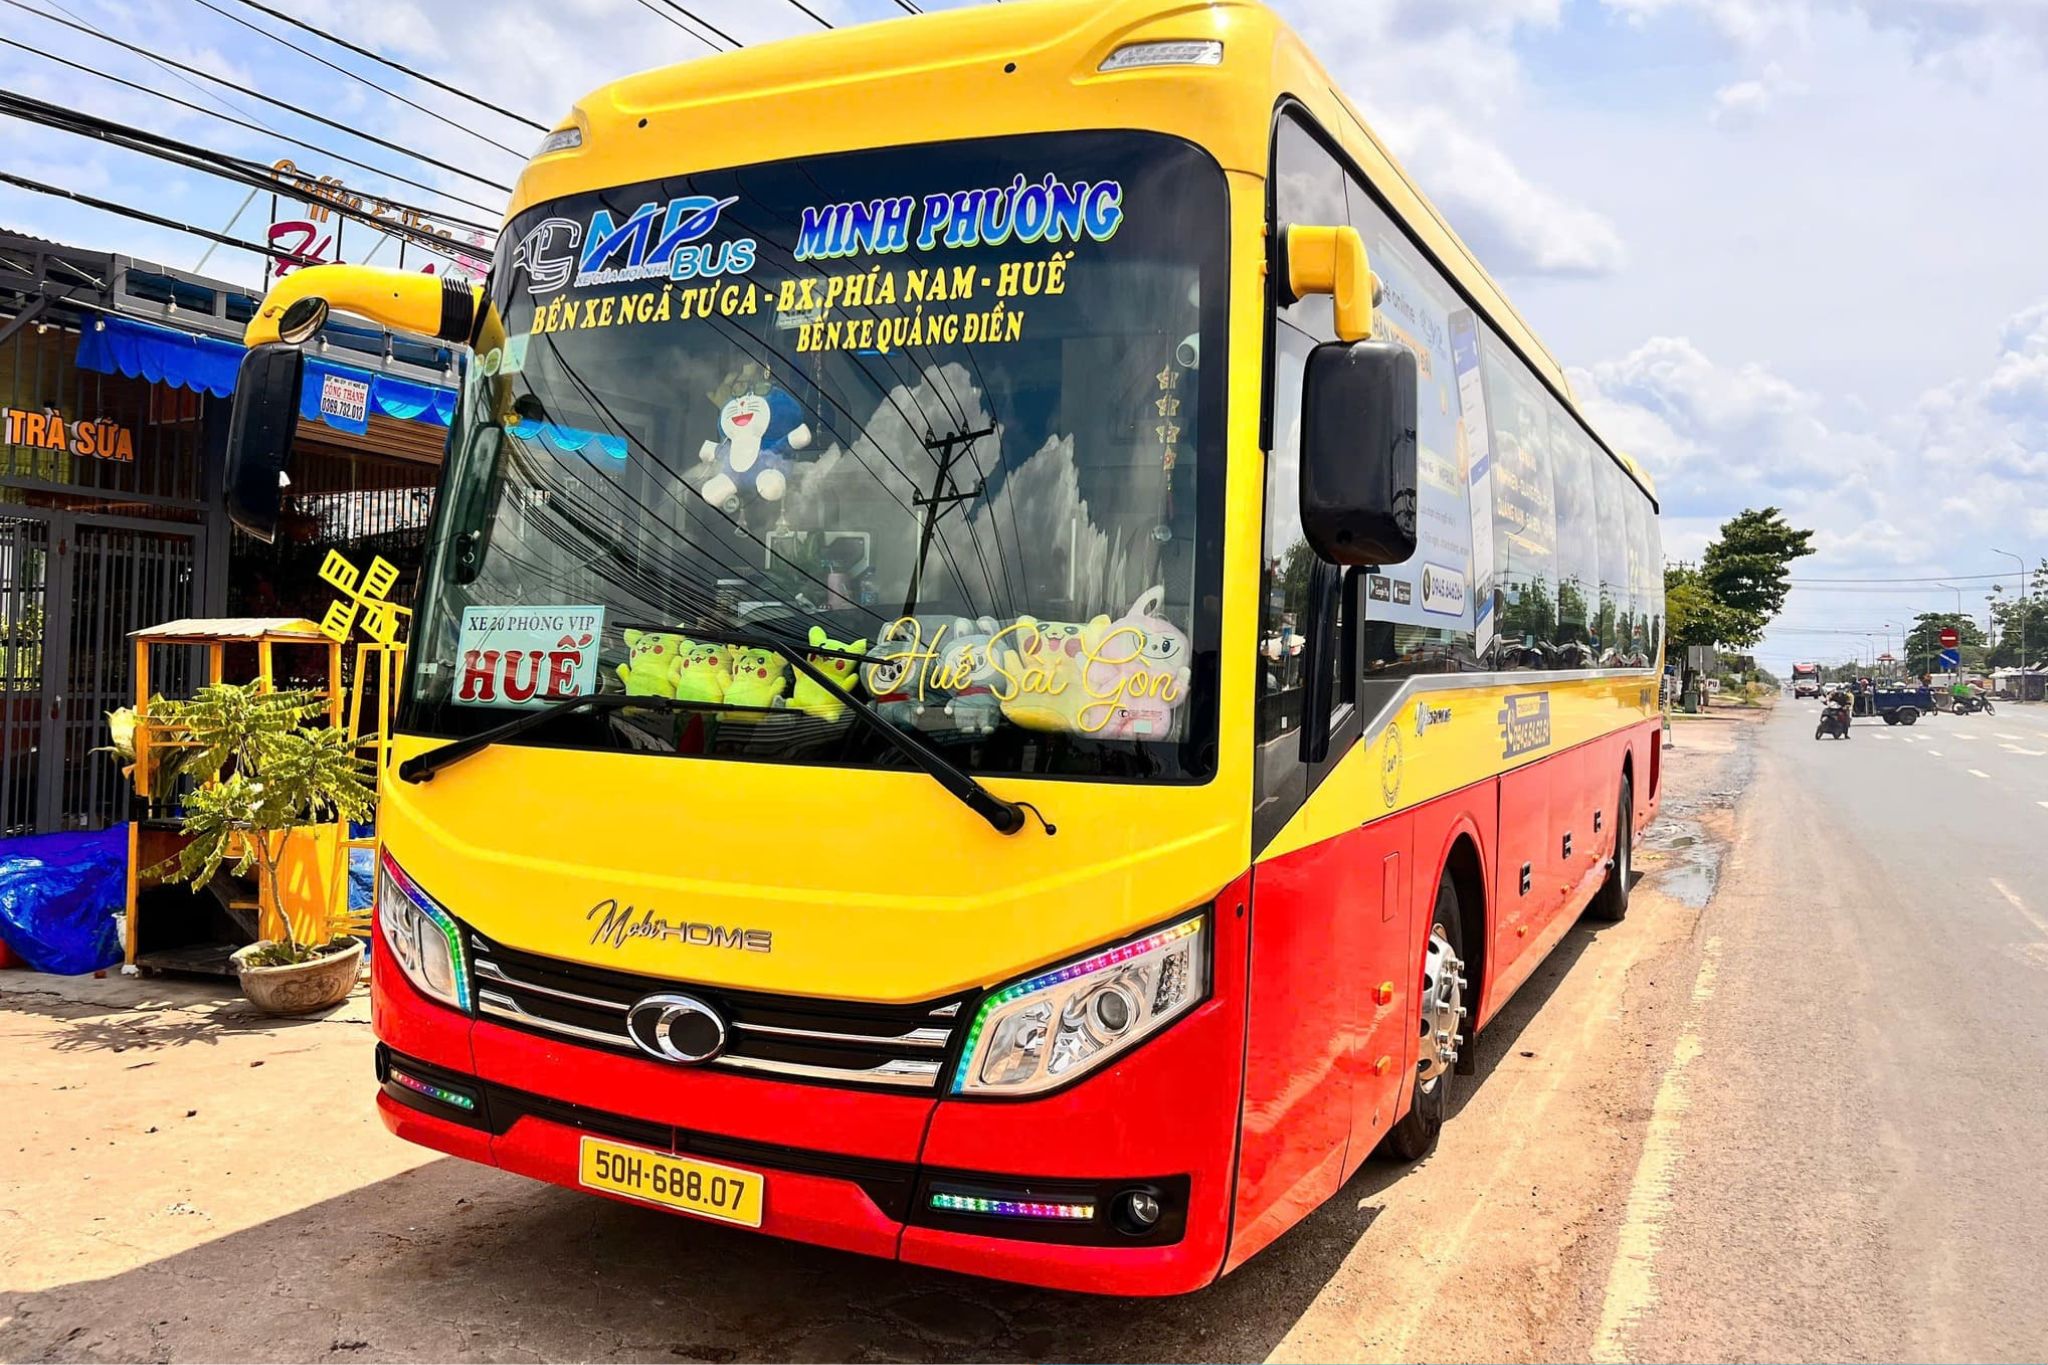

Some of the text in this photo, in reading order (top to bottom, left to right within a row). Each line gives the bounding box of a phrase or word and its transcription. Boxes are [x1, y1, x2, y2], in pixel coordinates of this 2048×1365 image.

[794, 172, 1124, 262] MINH PHƯƠNG
[670, 239, 756, 280] BUS
[530, 293, 580, 336] BẾN
[579, 296, 616, 328] XE
[616, 283, 673, 326] NGÃ
[680, 279, 721, 320] TƯ
[720, 282, 757, 317] GA
[903, 265, 977, 303] NAM
[996, 250, 1076, 298] HUẾ
[796, 312, 842, 352] BẾN
[841, 318, 874, 351] XE
[876, 304, 959, 355] QUẢNG
[961, 298, 1025, 344] ĐIỀN
[2, 407, 133, 462] TRÀ SỮA
[469, 616, 488, 631] XE
[568, 616, 595, 631] VIP
[458, 633, 595, 703] HUẾ
[596, 1149, 745, 1210] 50H-688.07
